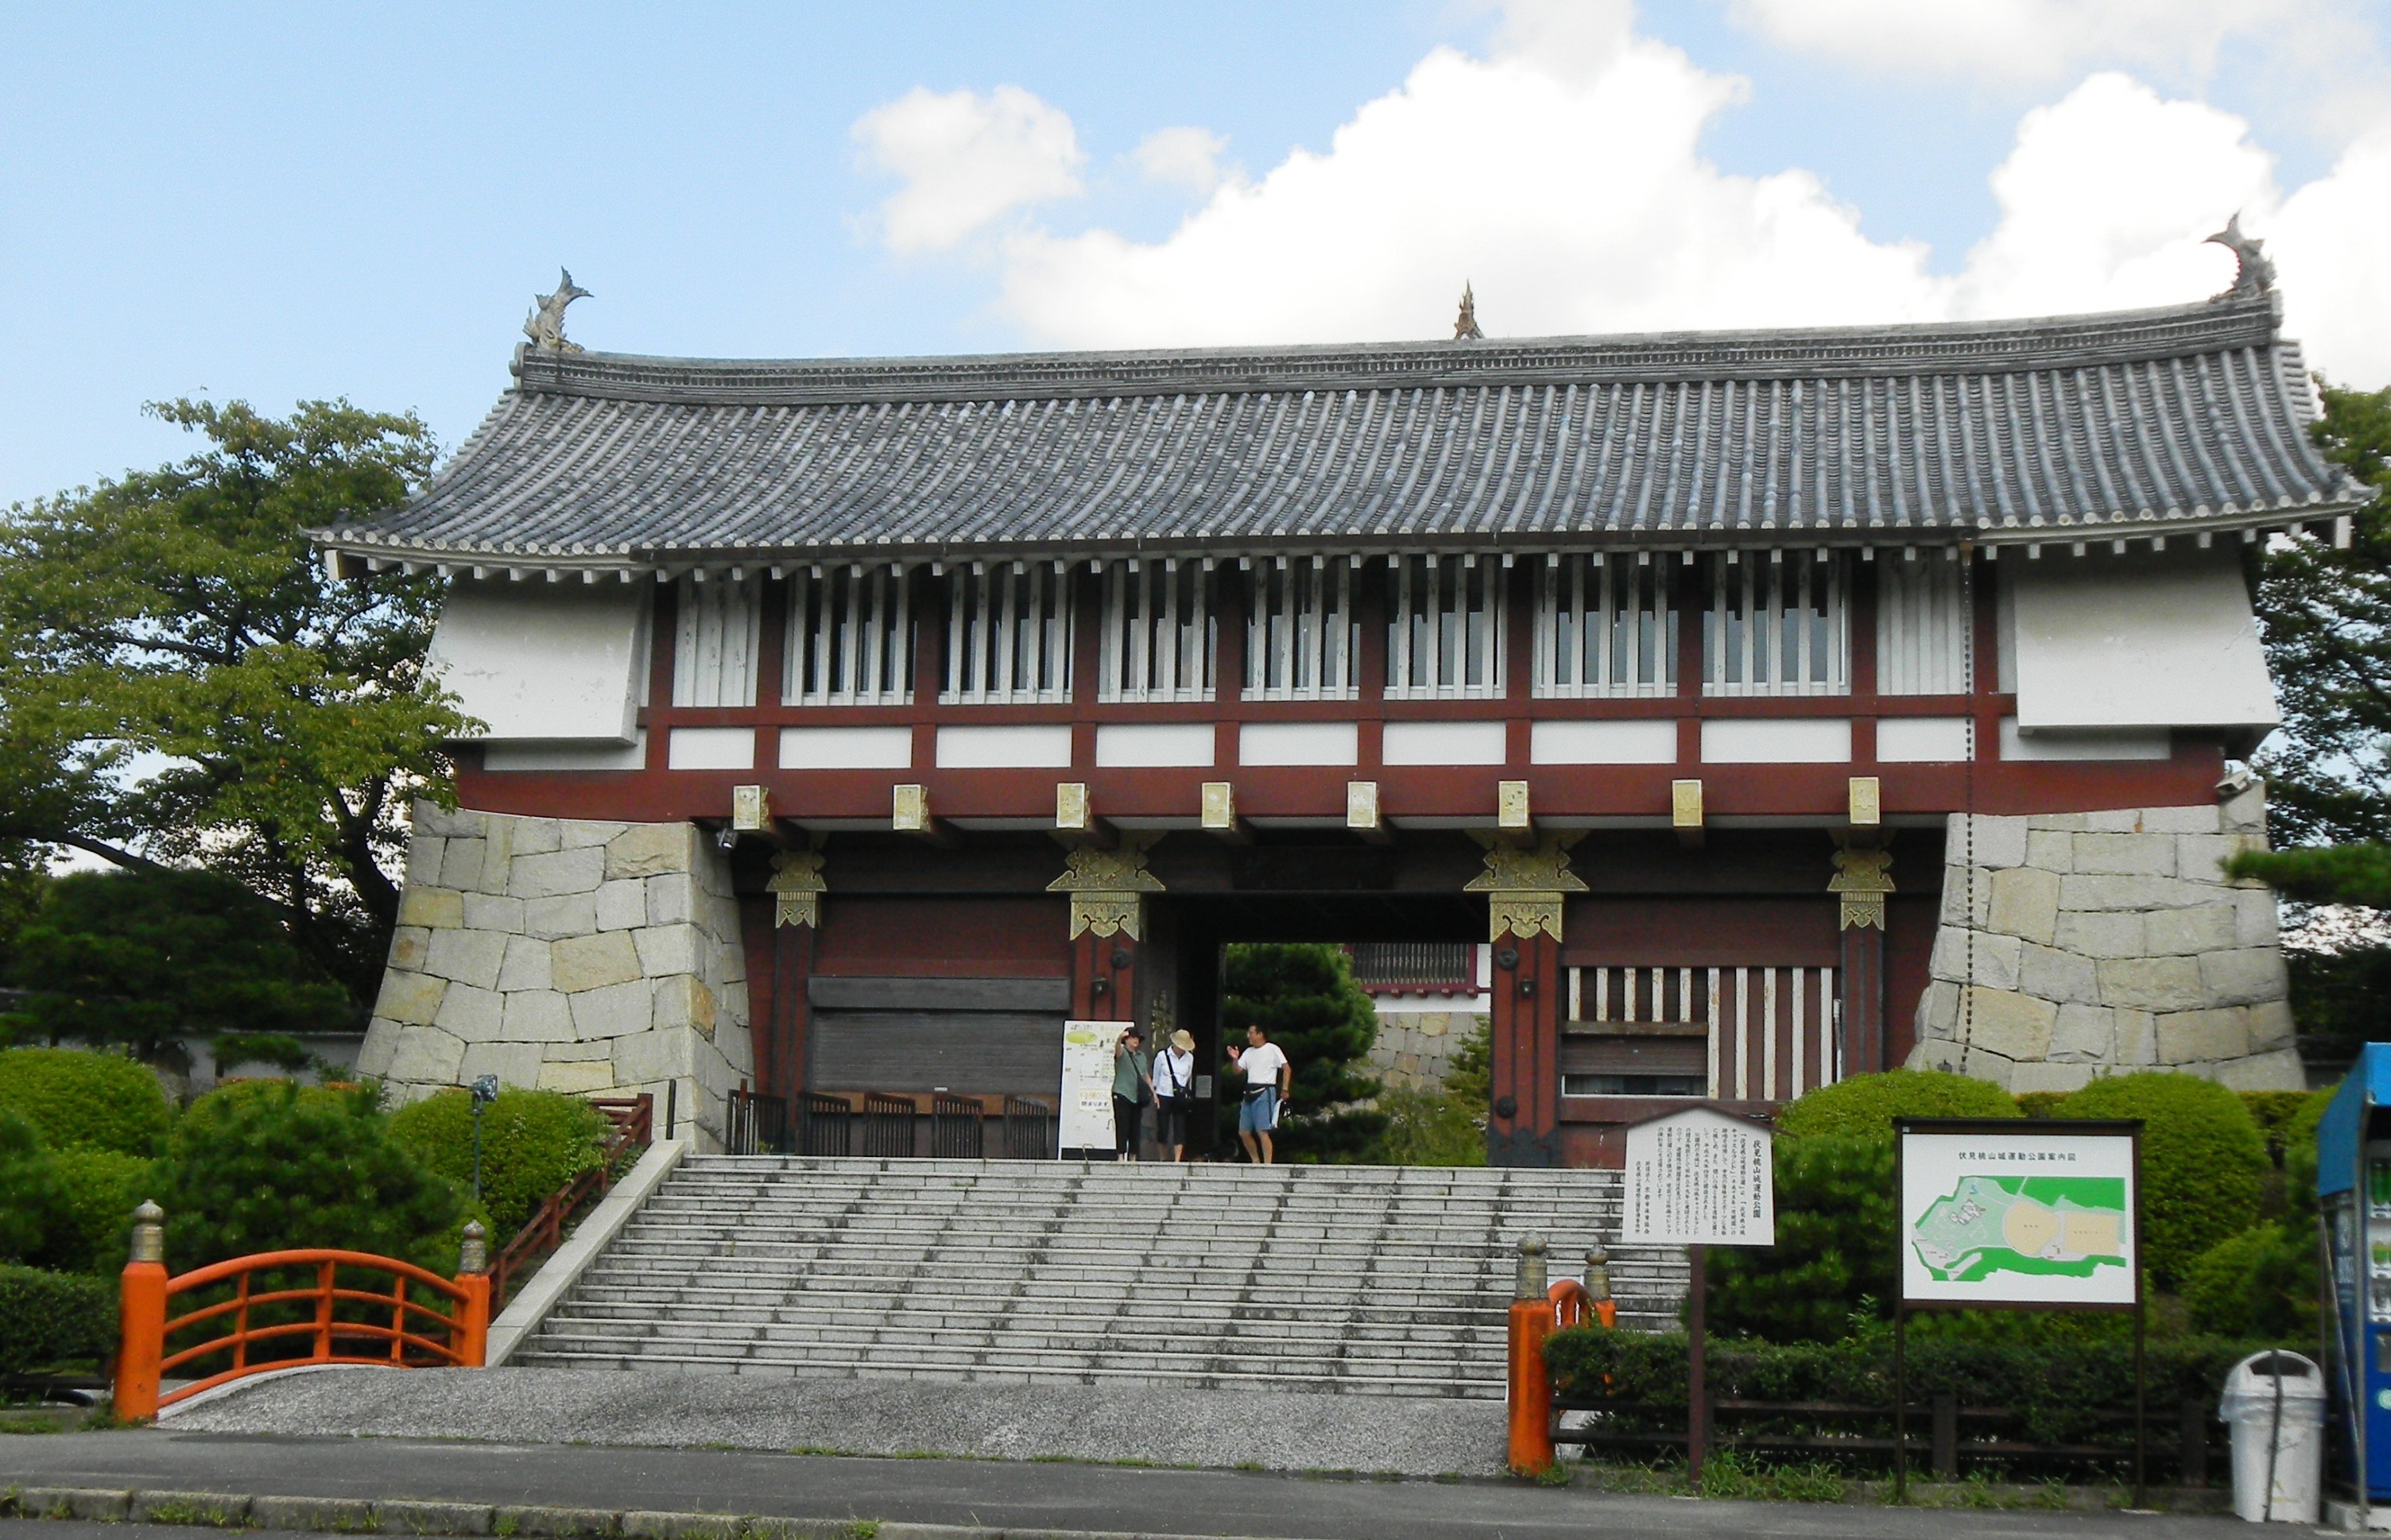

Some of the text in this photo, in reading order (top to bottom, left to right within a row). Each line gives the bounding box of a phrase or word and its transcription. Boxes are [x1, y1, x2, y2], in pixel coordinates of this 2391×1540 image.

[1753, 1139, 1762, 1219] 伏見桃山城運動公園
[1958, 1151, 2076, 1162] 伏見桃山城運動公園案内図
